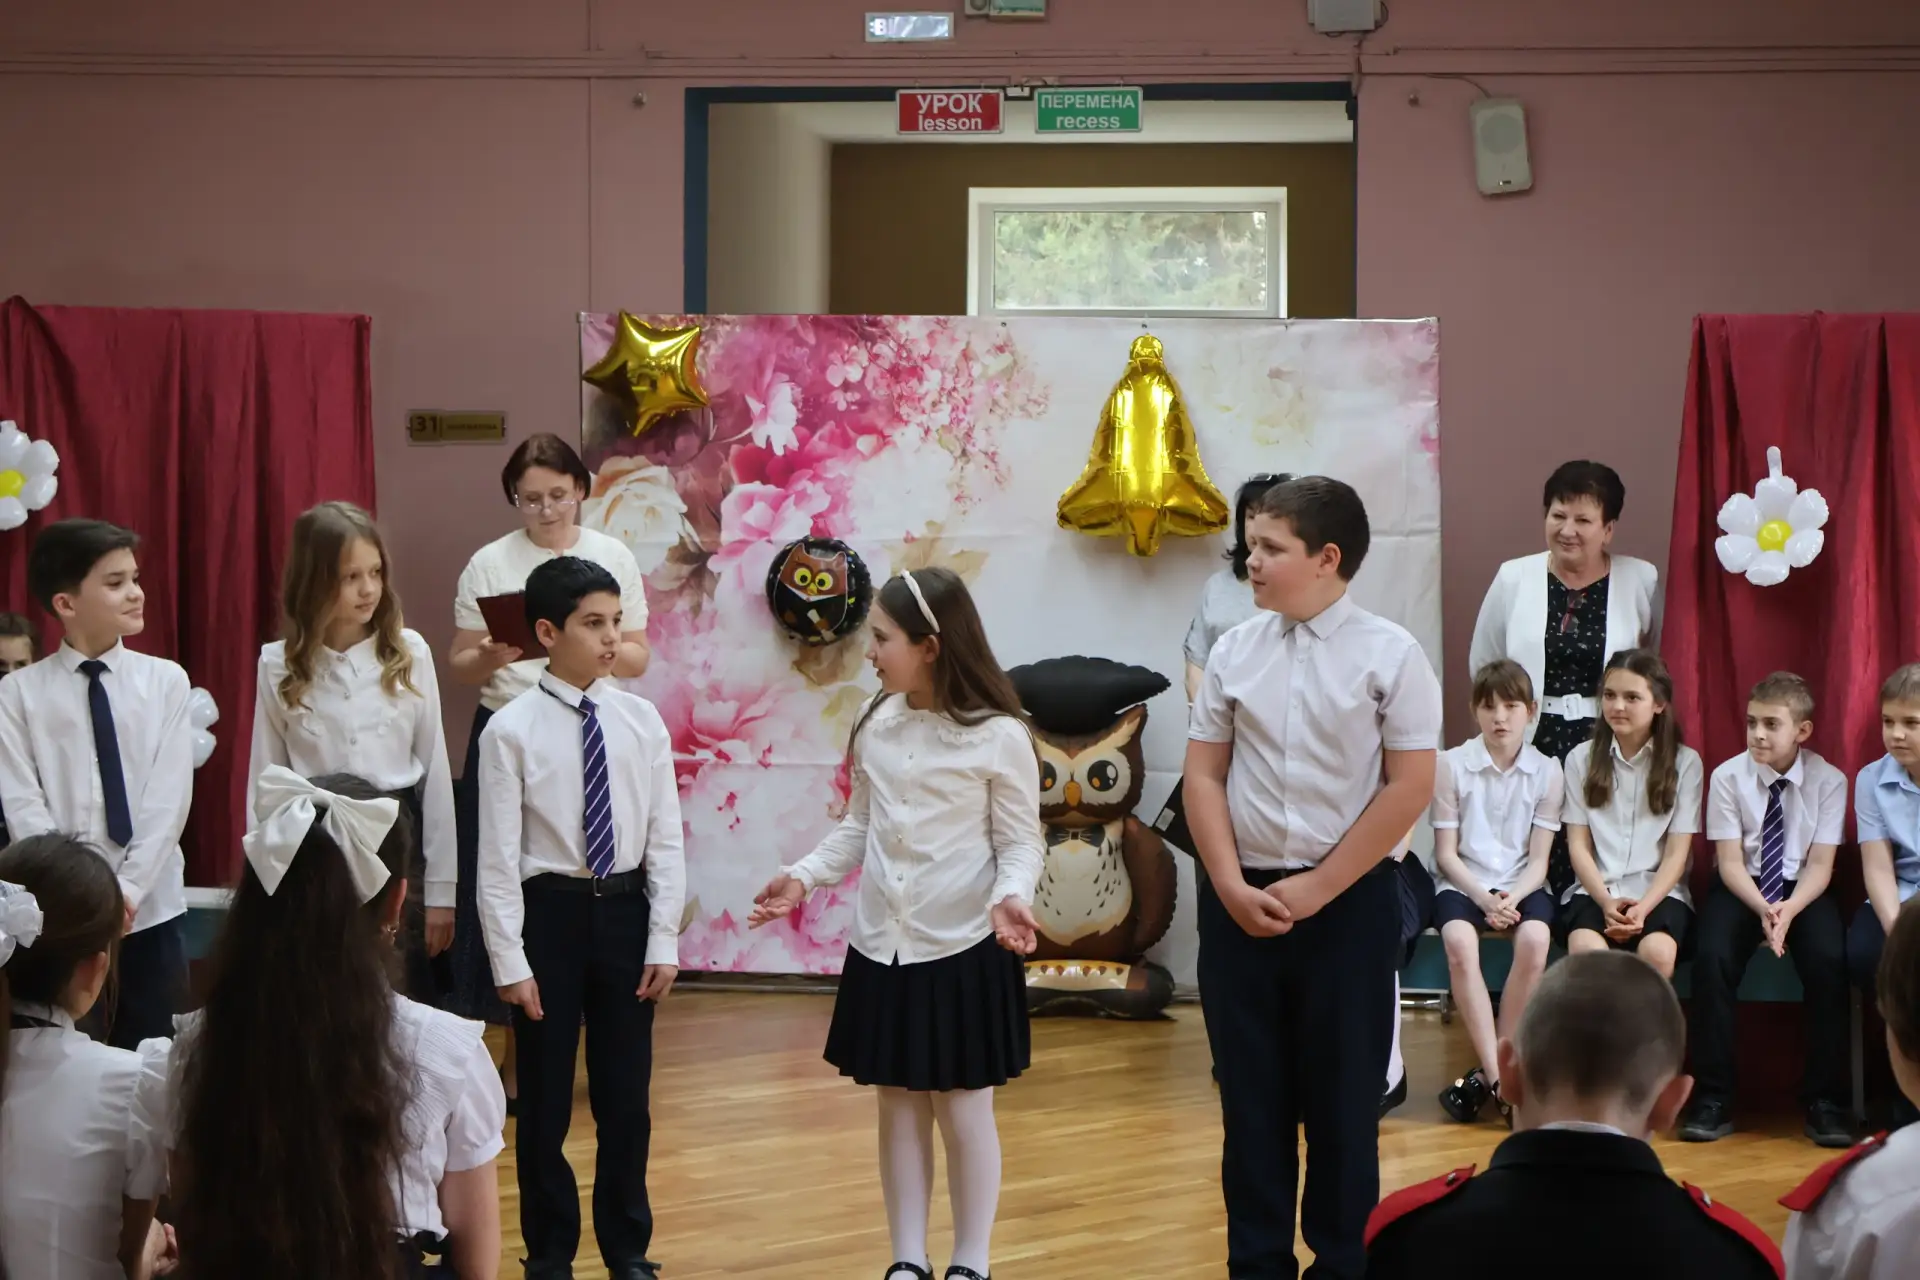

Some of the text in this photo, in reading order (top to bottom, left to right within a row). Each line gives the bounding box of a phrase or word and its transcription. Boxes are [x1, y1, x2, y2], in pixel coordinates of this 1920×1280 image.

[917, 93, 983, 114] УРОК
[1041, 94, 1136, 109] ПЕРЕМЕНА
[918, 114, 982, 132] lesson
[1056, 115, 1121, 129] recess
[413, 415, 438, 434] 31
